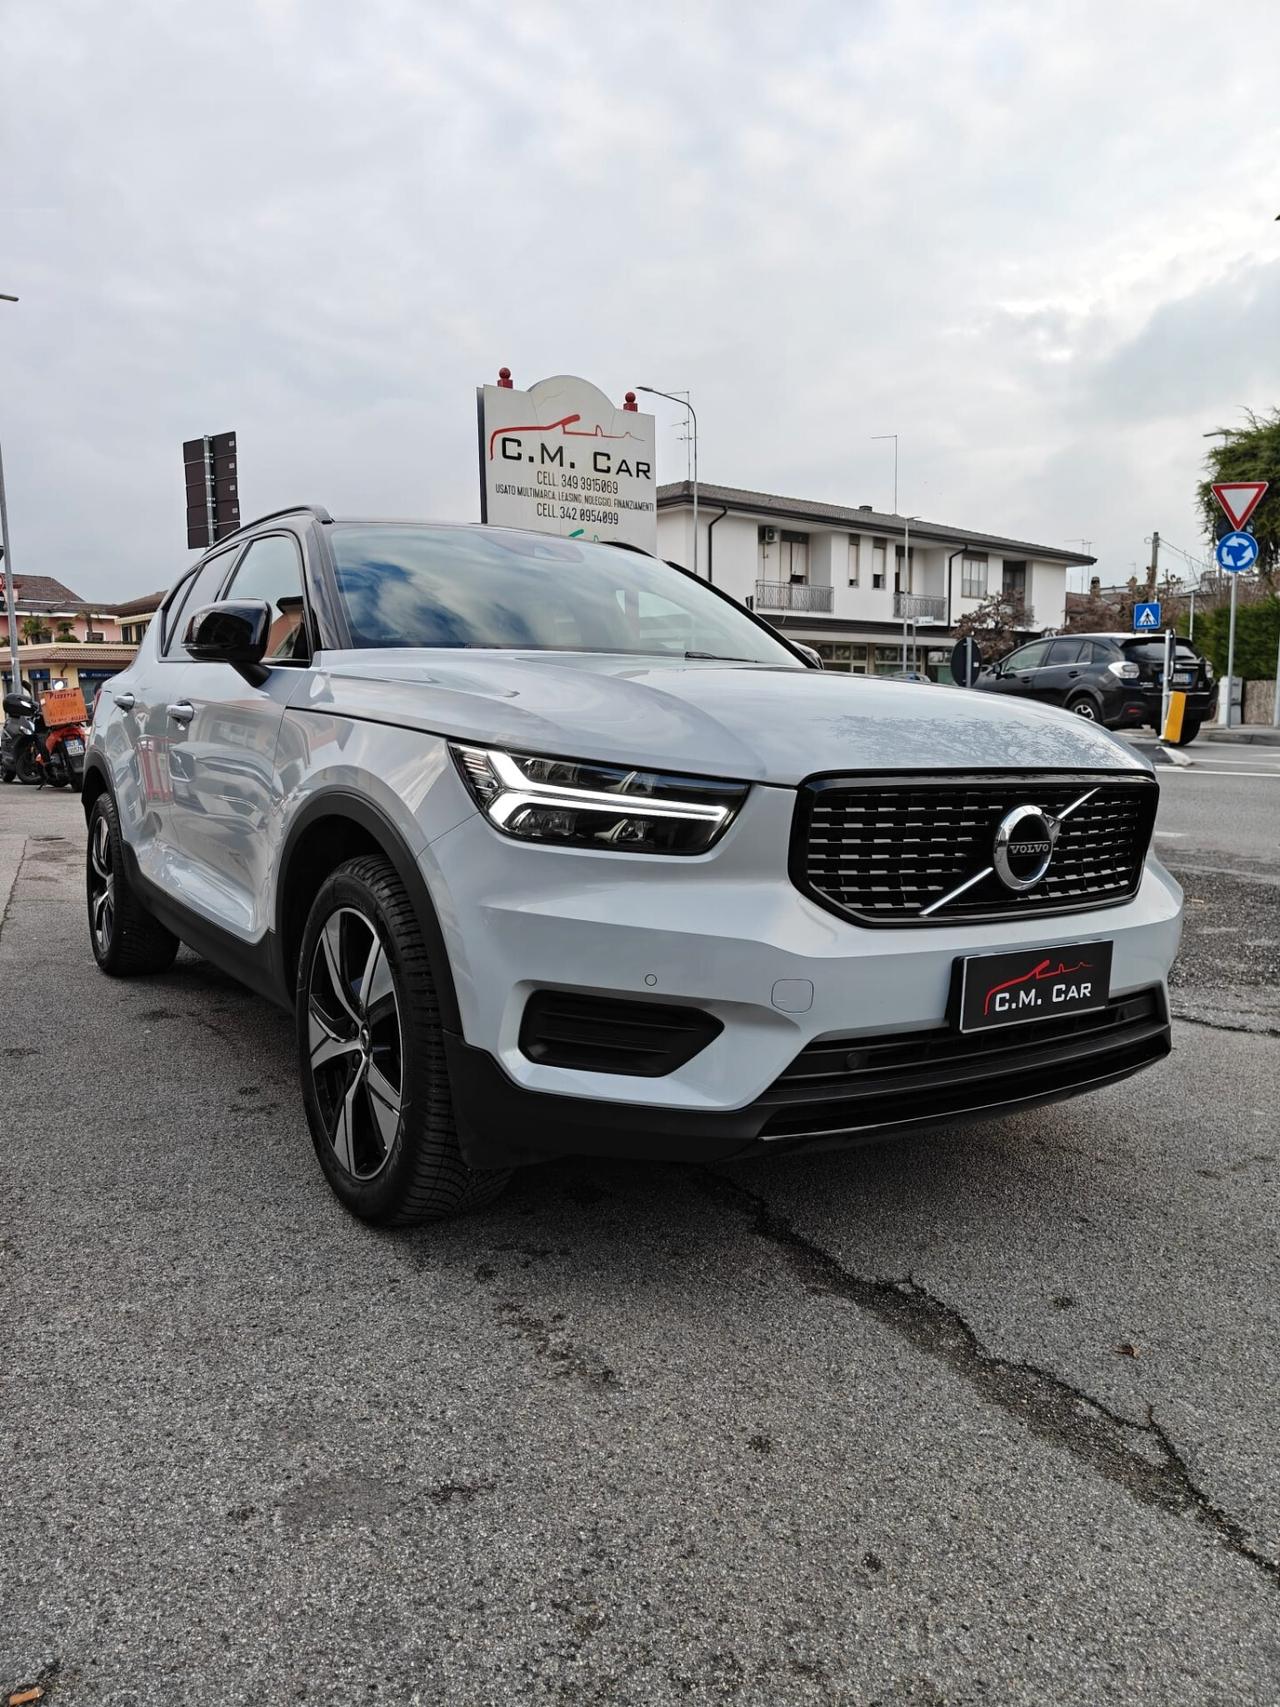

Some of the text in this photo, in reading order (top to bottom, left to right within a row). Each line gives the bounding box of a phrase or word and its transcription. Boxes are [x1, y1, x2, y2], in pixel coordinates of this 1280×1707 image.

[502, 437, 652, 480] C.M. CAR
[561, 474, 578, 489] 349
[581, 477, 618, 494] 3915069
[496, 484, 516, 495] USATO
[614, 498, 654, 512] FINANZIAMENTI
[559, 506, 577, 521] 342
[580, 509, 619, 525] 0954099
[1009, 844, 1049, 854] VOLVO
[995, 982, 1091, 1012] C.M. CAR
